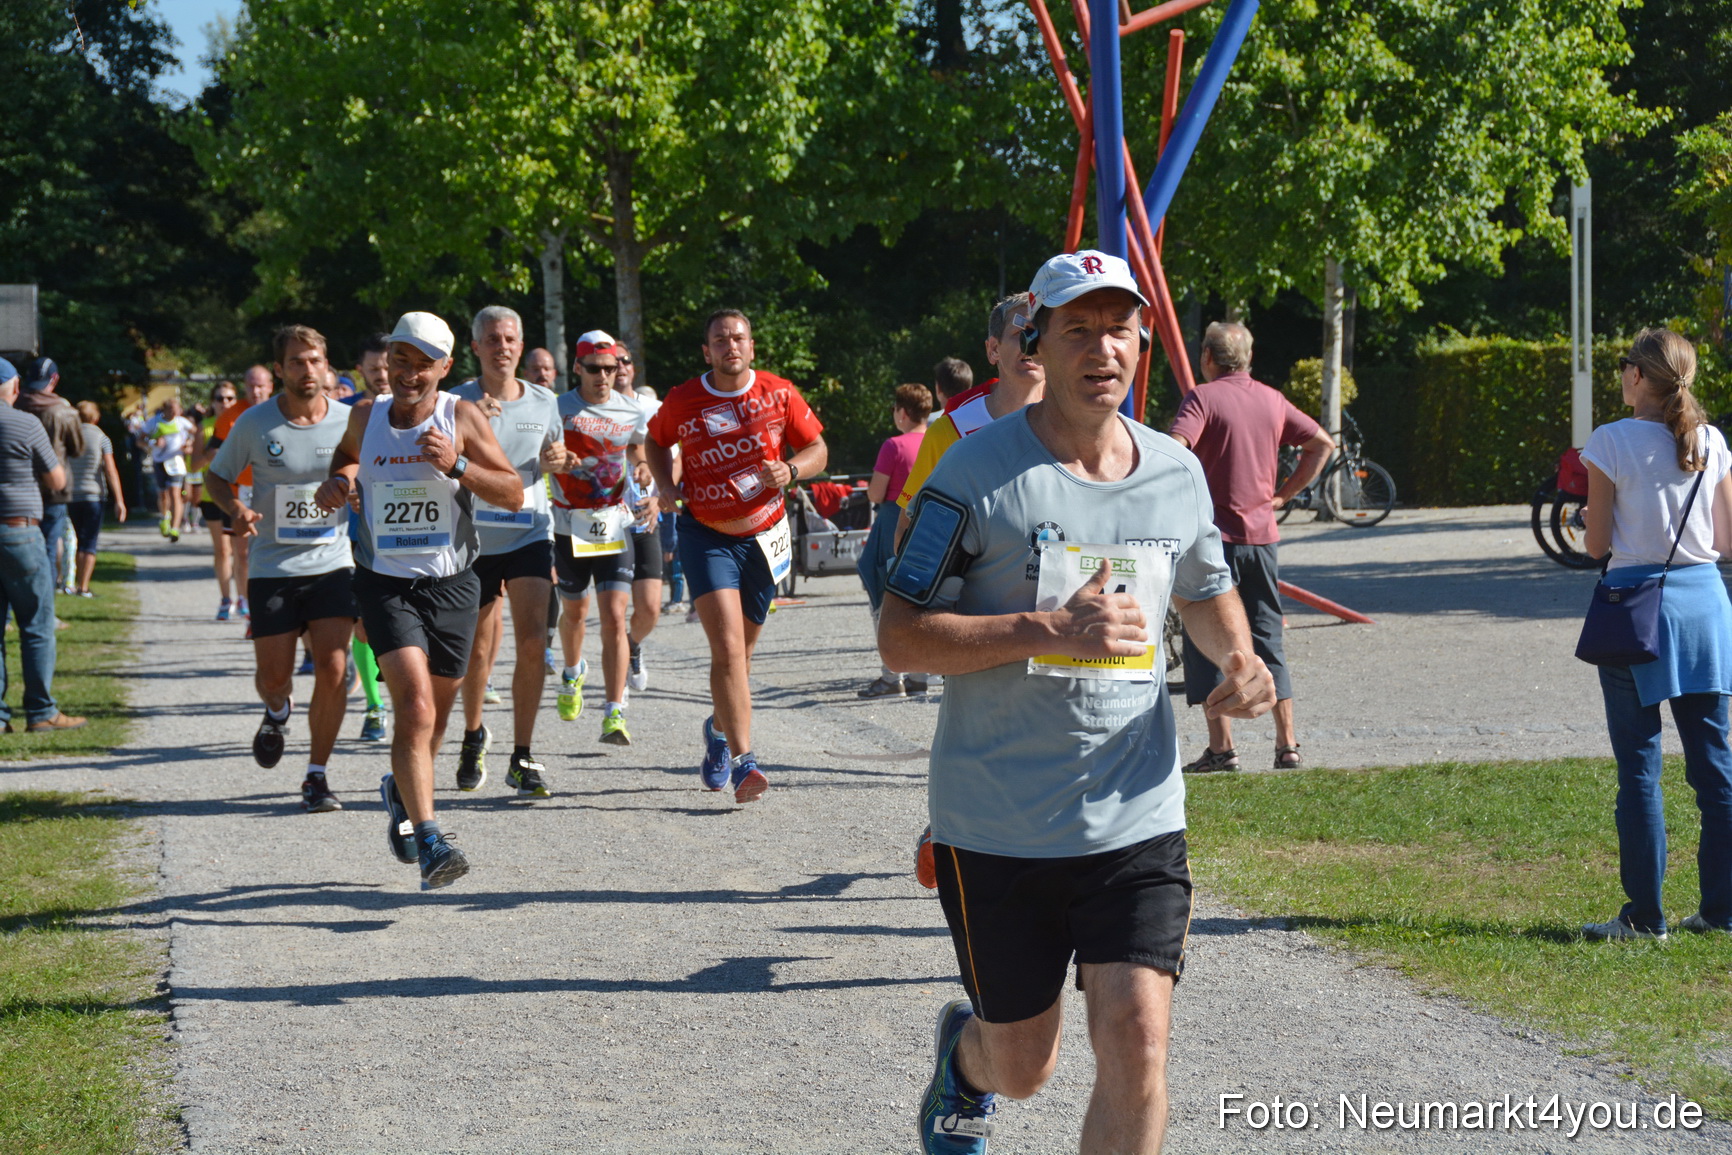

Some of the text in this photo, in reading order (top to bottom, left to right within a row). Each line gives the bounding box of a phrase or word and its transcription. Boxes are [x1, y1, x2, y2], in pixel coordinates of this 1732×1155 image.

[1080, 255, 1106, 275] R
[516, 422, 544, 431] BOCK
[394, 487, 427, 496] BOCK
[384, 501, 439, 524] 2276
[495, 513, 516, 521] David
[589, 521, 607, 537] 42
[1034, 521, 1063, 535] BMW
[396, 536, 429, 546] Roland
[1026, 563, 1040, 574] PA
[1080, 555, 1137, 573] BOCK
